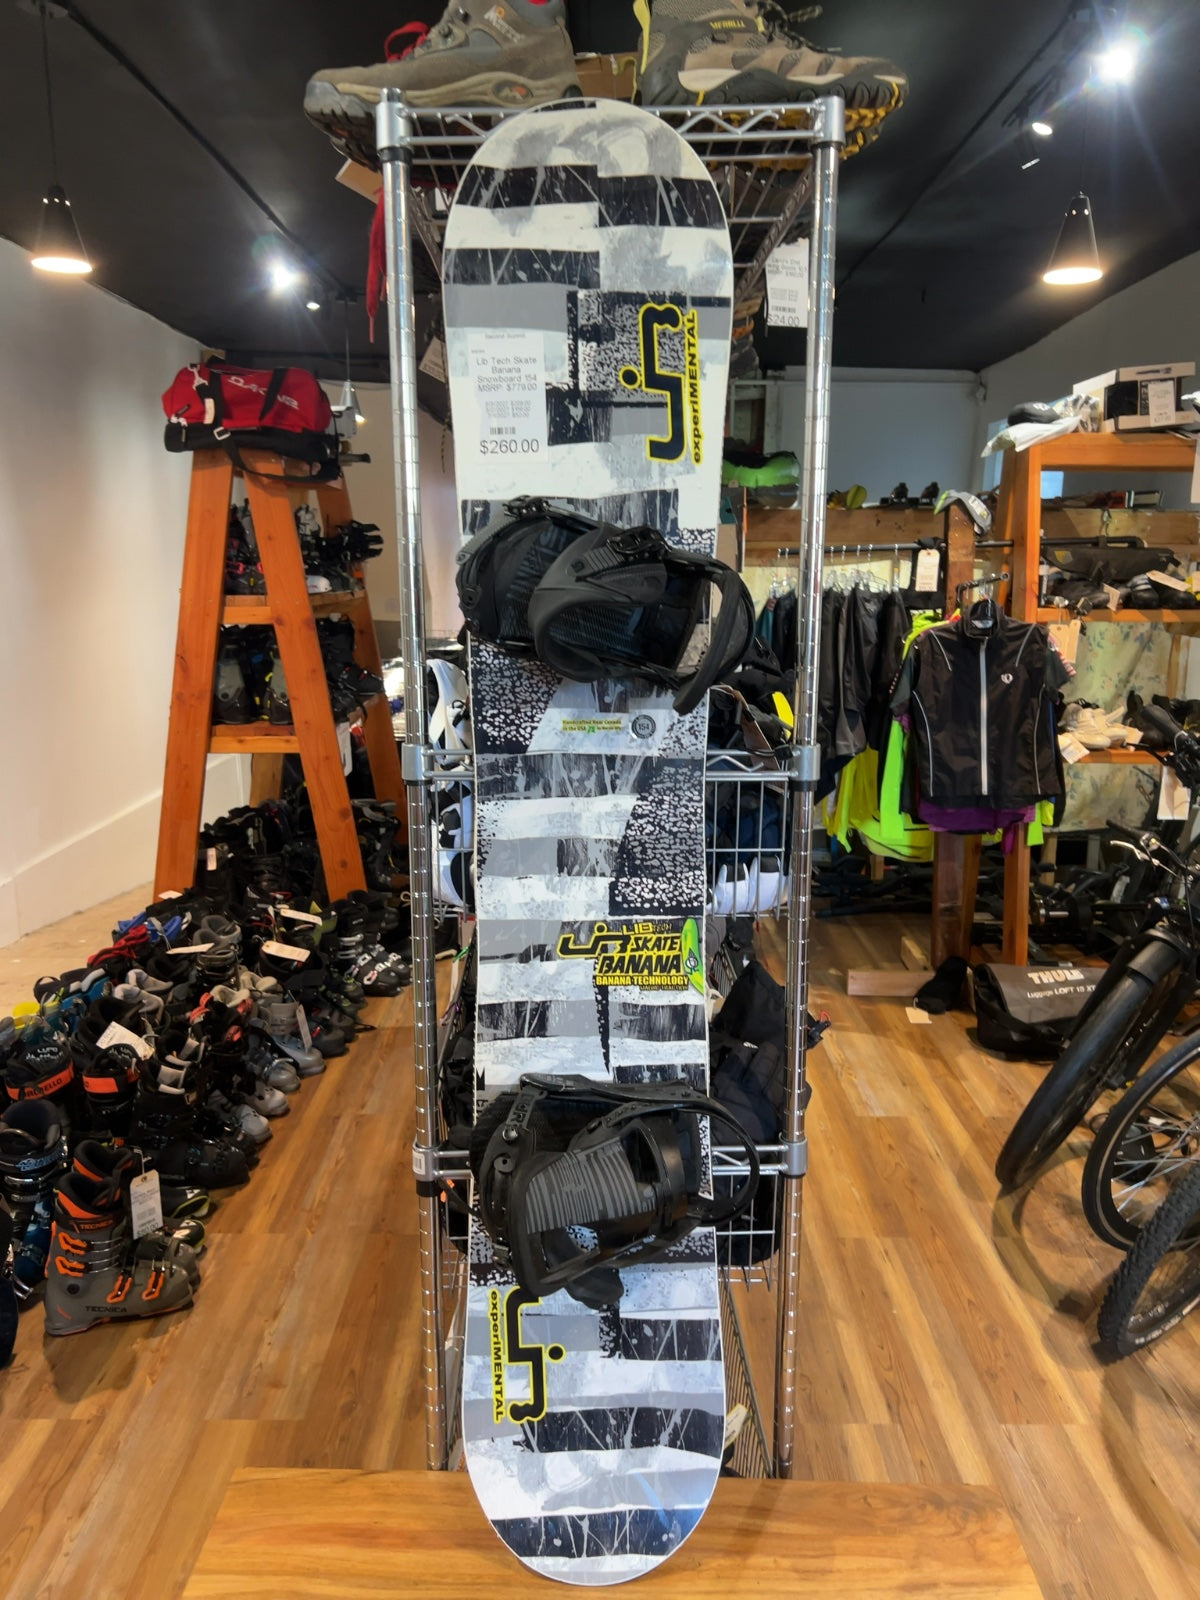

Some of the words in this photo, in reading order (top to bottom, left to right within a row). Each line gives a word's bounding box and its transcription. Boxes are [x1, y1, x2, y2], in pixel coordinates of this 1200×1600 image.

[767, 313, 800, 327] $24.00
[477, 357, 488, 366] Lib
[491, 356, 510, 365] Tech
[513, 356, 537, 365] Skate
[491, 366, 521, 374] Banana
[477, 374, 522, 384] Snowboard
[524, 374, 537, 382] 154
[686, 309, 702, 464] experiMENTAL
[479, 438, 539, 455] $260.00
[638, 723, 650, 731] 154
[622, 921, 653, 936] LIB
[630, 935, 681, 953] SKATE
[600, 953, 683, 975] BANANA
[596, 974, 632, 986] BANANA
[633, 974, 689, 986] TECHNOLOGY
[84, 1305, 127, 1313] TECNICA
[490, 1290, 504, 1421] experiMENTAL
